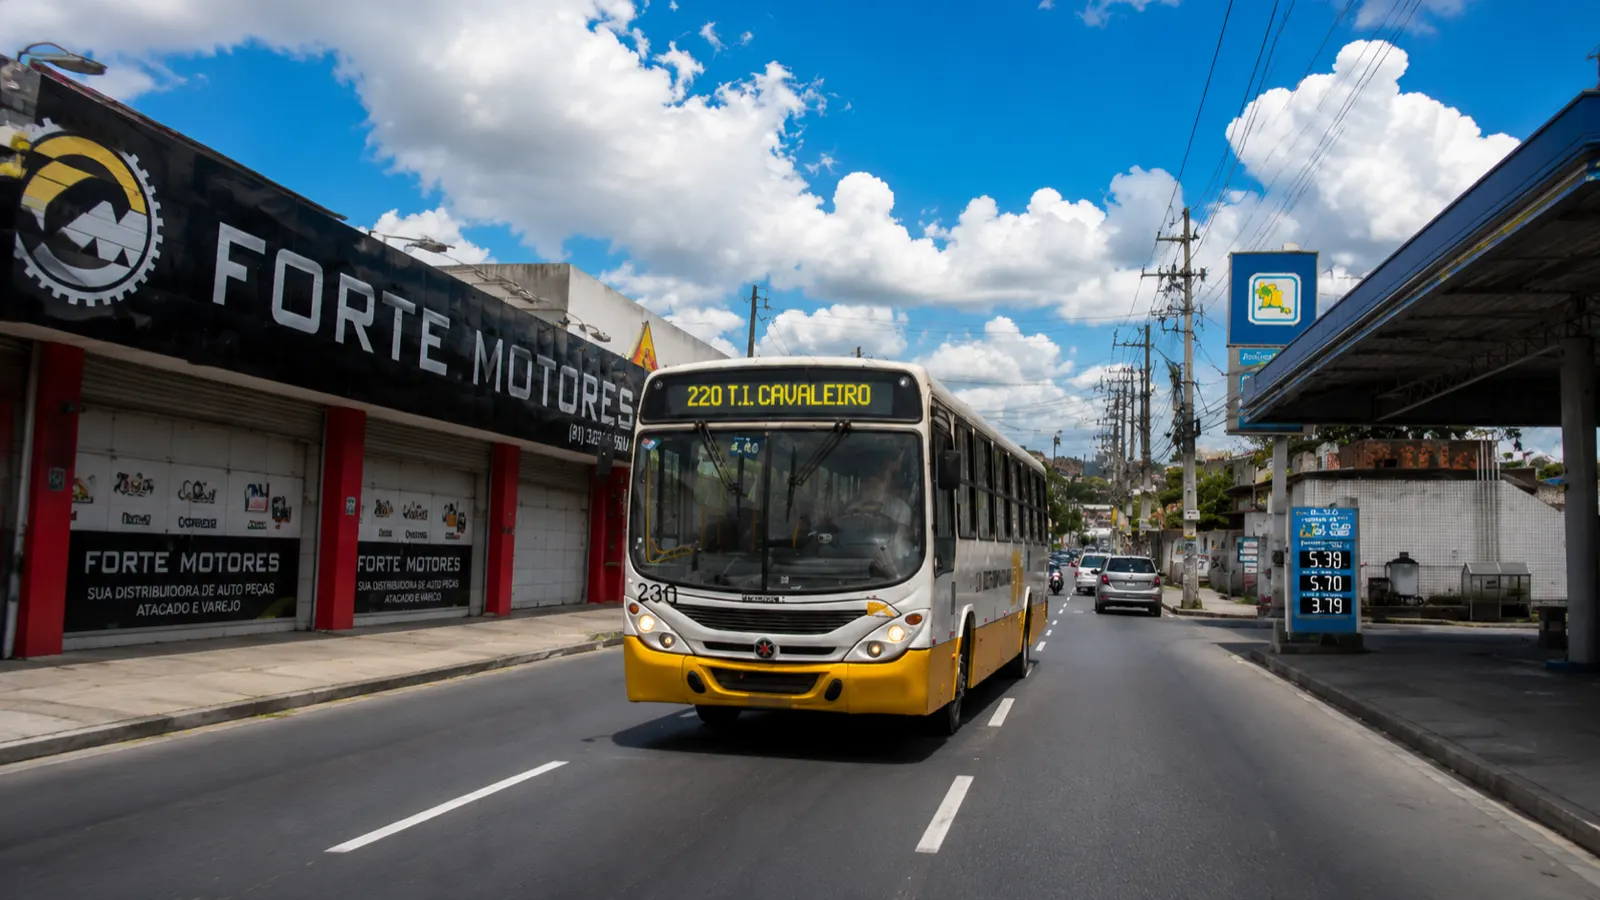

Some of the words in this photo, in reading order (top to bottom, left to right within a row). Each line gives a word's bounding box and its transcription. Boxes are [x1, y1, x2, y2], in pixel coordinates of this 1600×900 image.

[212, 221, 451, 377] FORTE
[472, 329, 634, 431] MOTORES
[687, 385, 723, 407] 220
[727, 385, 755, 407] T.I.
[758, 384, 872, 406] CAVALEIRO
[84, 551, 169, 574] FORTE
[179, 551, 280, 574] MOTORES
[357, 556, 401, 572] FORTE
[406, 557, 461, 572] MOTORES
[1308, 551, 1342, 569] 5.39
[87, 586, 113, 601] SUA
[201, 584, 215, 597] DE
[216, 583, 243, 597] AUTO
[244, 582, 275, 597] PEÇAS
[1309, 575, 1342, 591] 5.70
[637, 583, 678, 605] 230
[135, 602, 191, 617] ATACADO
[191, 601, 199, 614] E
[200, 600, 241, 614] VAREJO
